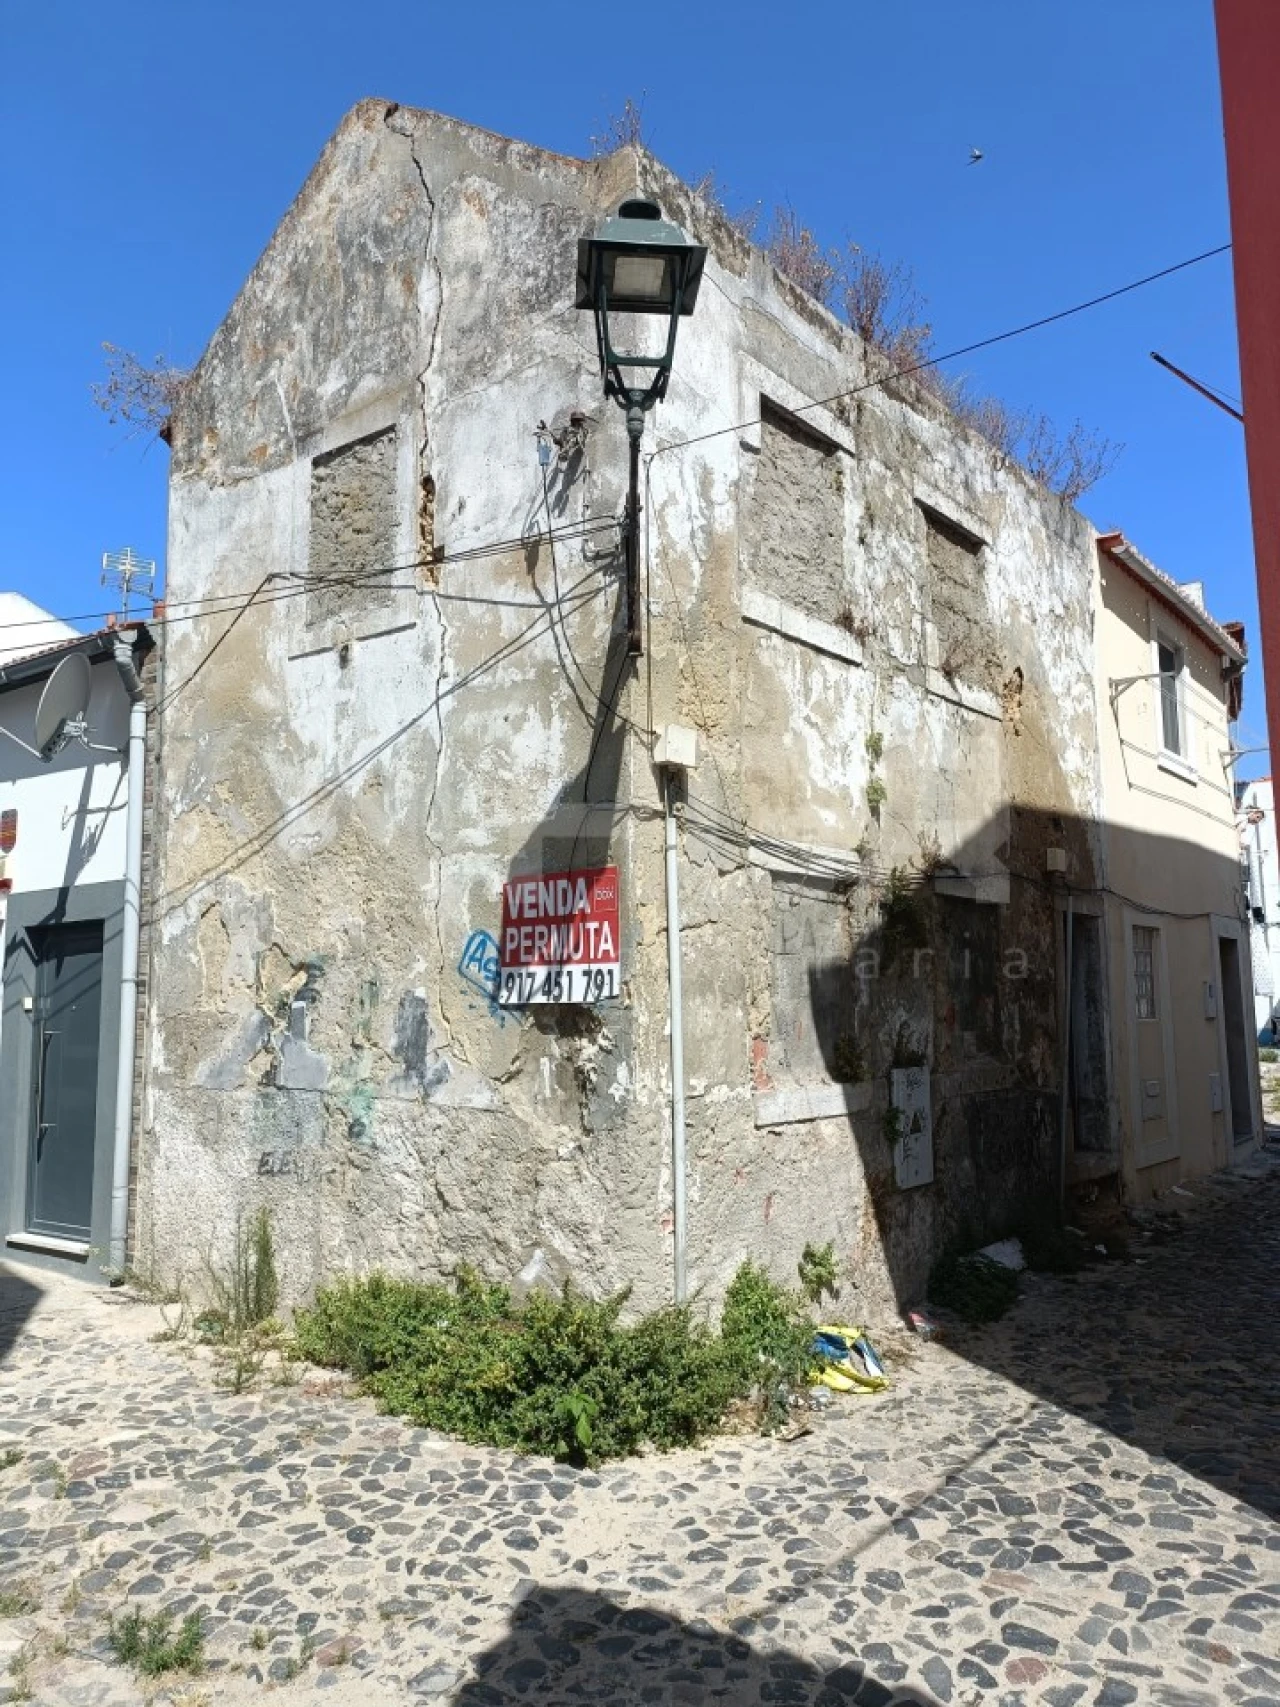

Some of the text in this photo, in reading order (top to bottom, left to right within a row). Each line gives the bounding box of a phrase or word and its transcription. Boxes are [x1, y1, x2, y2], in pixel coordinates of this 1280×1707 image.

[507, 878, 591, 919] VENDA
[505, 921, 615, 963] PERMUTA
[504, 968, 616, 1003] 917 451 791
